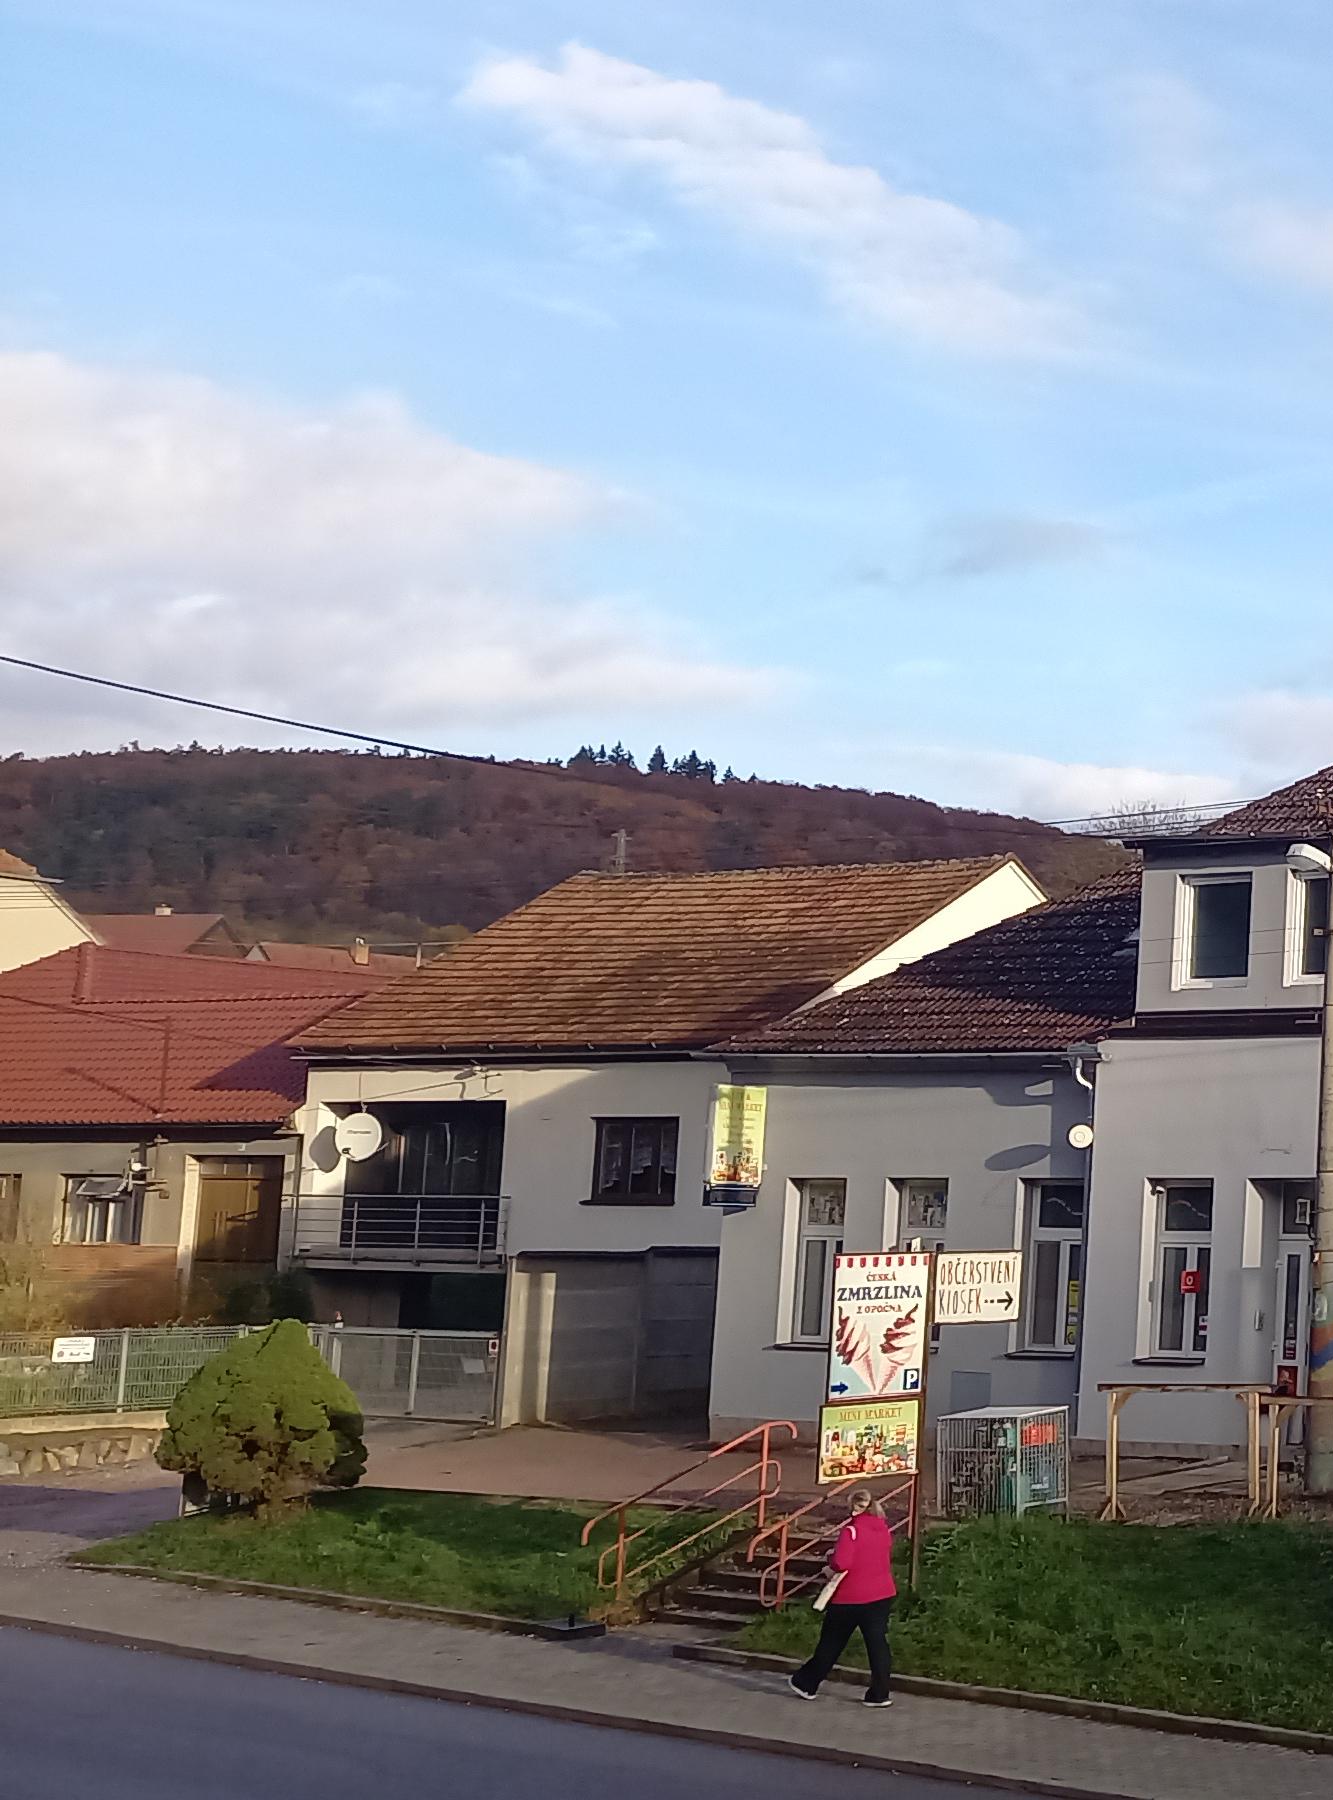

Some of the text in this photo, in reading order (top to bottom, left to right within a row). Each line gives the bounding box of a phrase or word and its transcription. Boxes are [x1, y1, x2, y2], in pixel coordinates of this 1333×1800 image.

[940, 1256, 1017, 1286] OBČERSTVENÍ
[837, 1285, 923, 1302] ZMRZLINA
[939, 1288, 981, 1315] KIOSEK
[906, 1370, 918, 1389] P
[865, 1407, 903, 1420] MARKET
